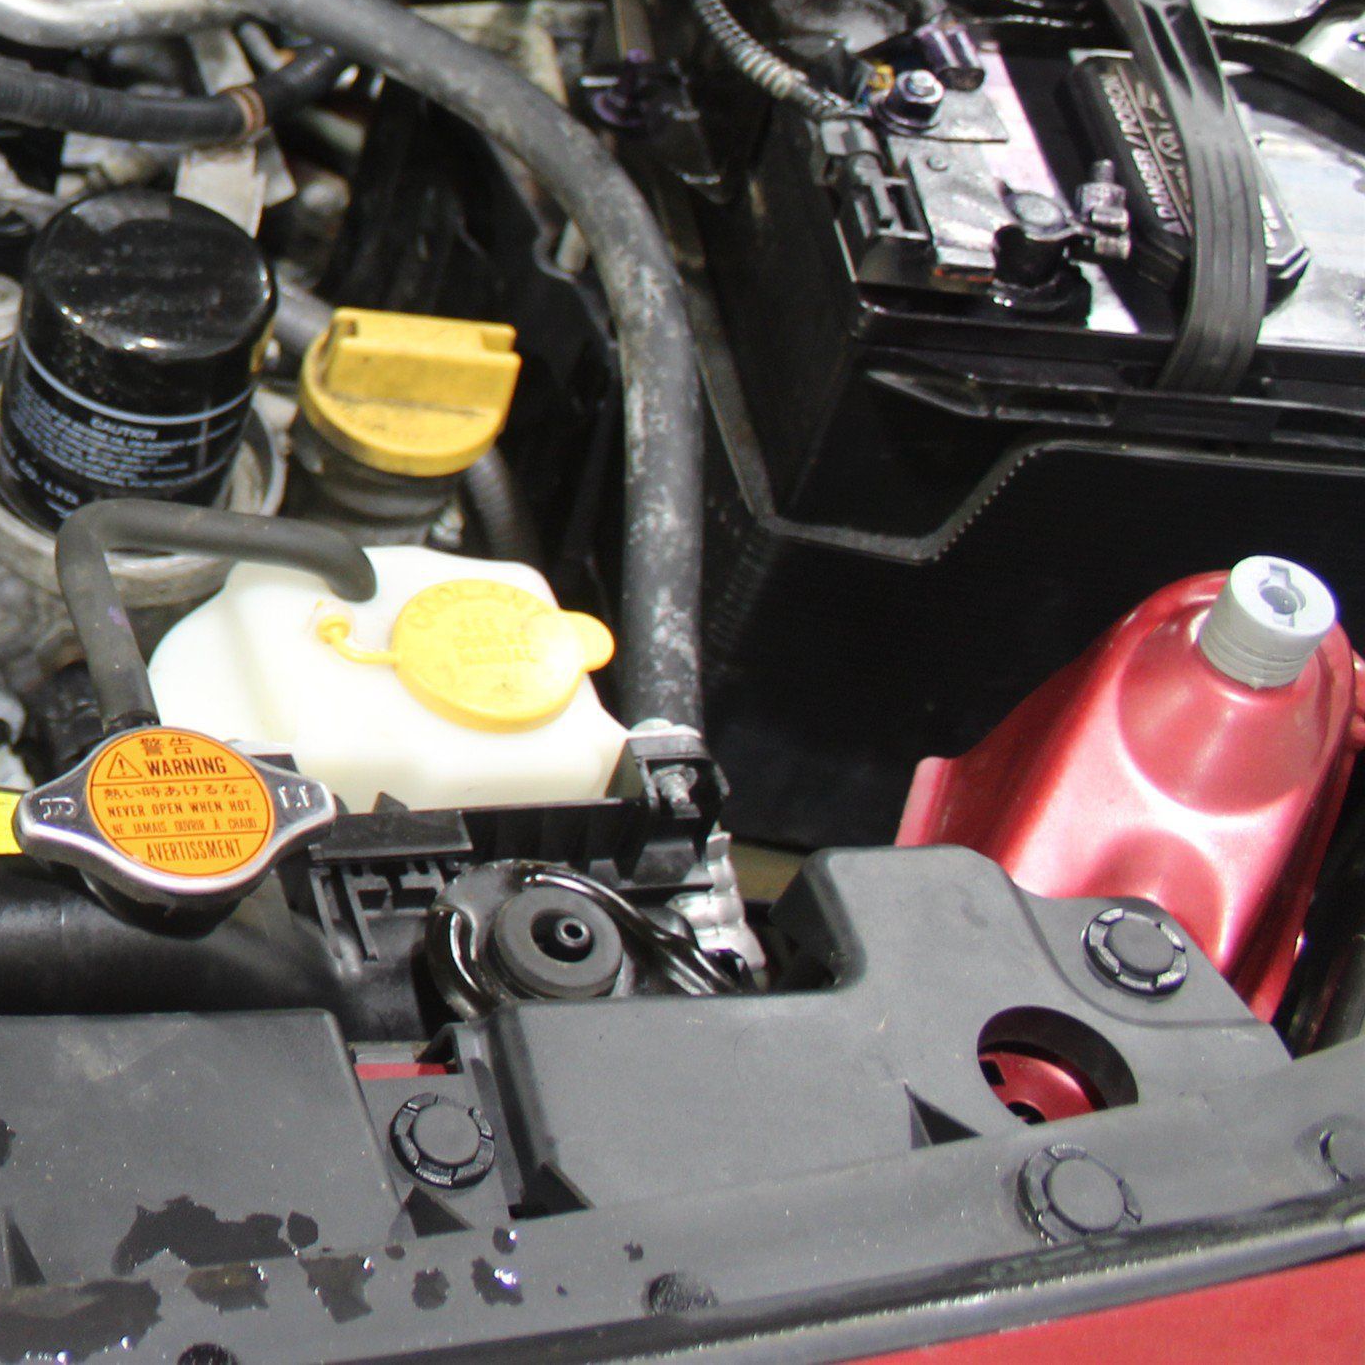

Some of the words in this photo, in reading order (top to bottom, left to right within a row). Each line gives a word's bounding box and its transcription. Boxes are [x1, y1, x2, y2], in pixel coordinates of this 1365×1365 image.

[90, 418, 158, 440] CAUTION
[139, 737, 193, 757] 警告
[144, 756, 227, 778] WARNING
[107, 804, 145, 819] NEVER
[151, 802, 183, 816] OPEN
[190, 800, 223, 815] WHEN
[112, 823, 128, 835] NE
[132, 820, 167, 834] JAMAIS
[174, 818, 206, 833] OUVRIR
[145, 838, 243, 864] AVERTISSMENT
